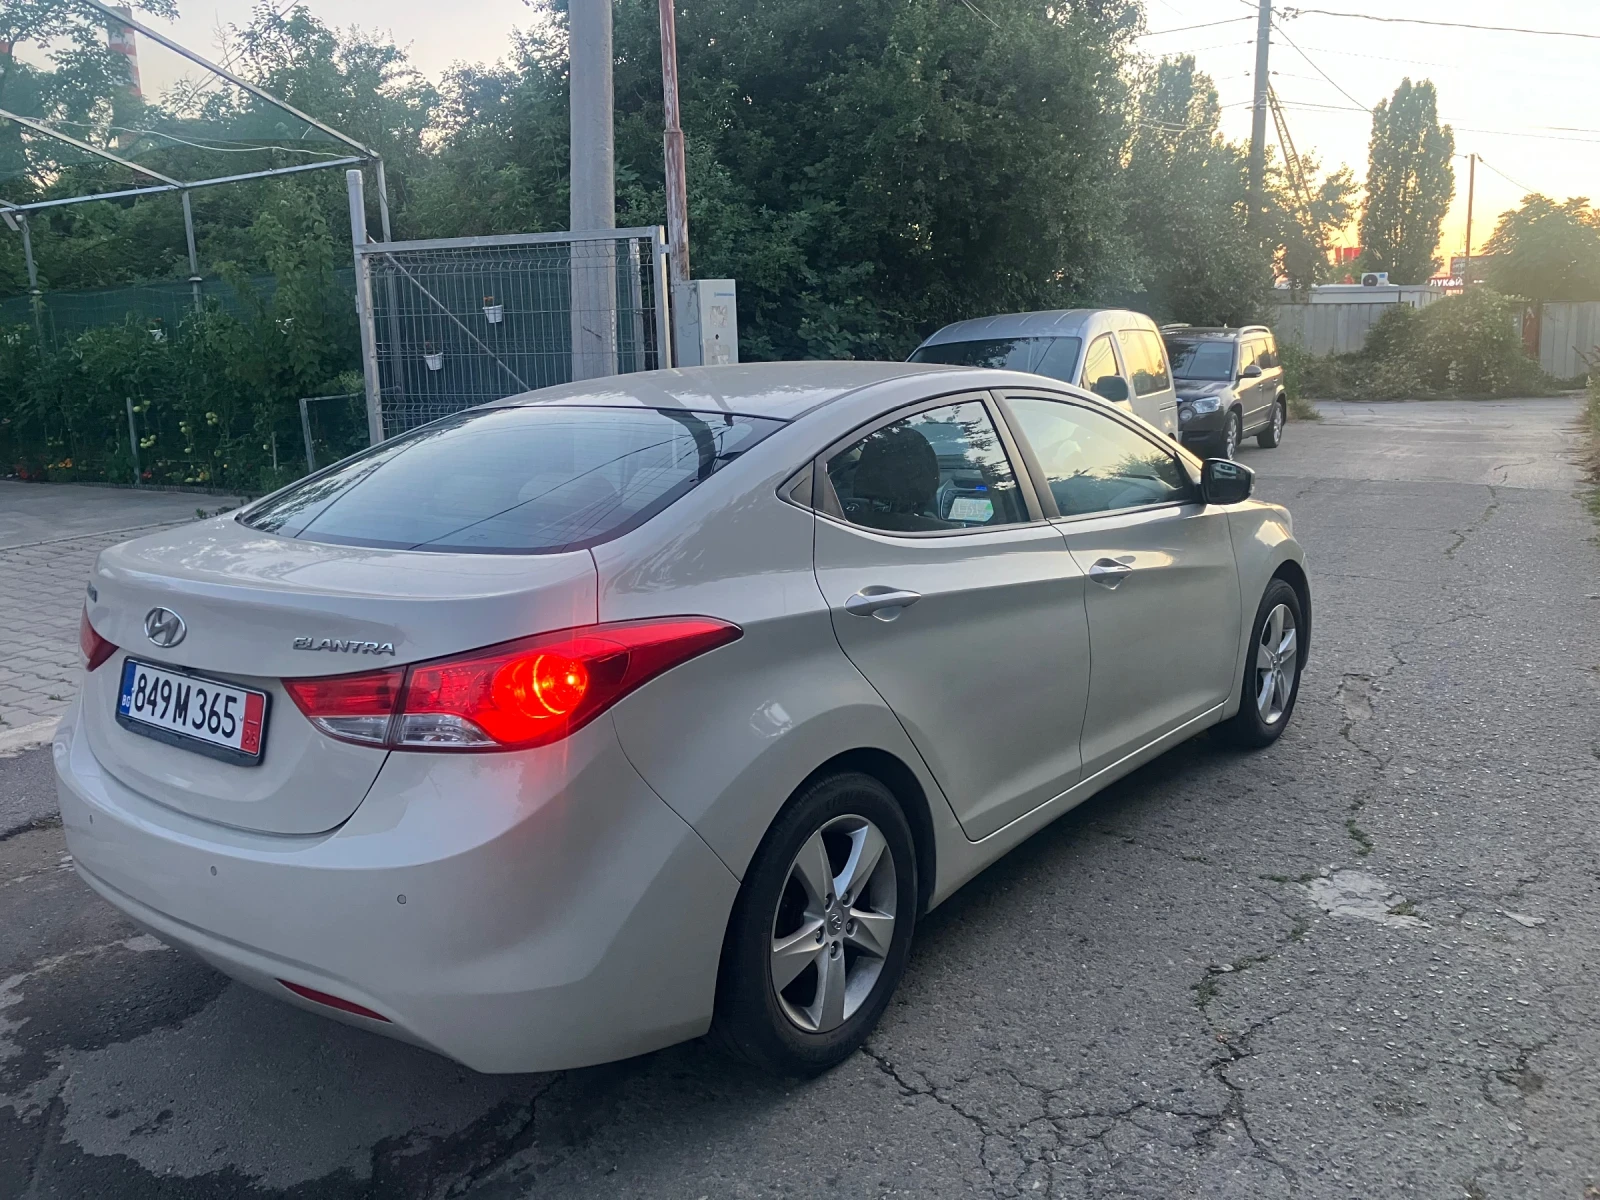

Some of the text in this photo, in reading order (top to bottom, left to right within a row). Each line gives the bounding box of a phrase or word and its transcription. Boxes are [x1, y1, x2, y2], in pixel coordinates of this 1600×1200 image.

[1429, 276, 1464, 287] ЛУКОЙ
[293, 637, 396, 656] ELANTRA
[121, 694, 132, 708] BG
[134, 673, 238, 739] 849M365
